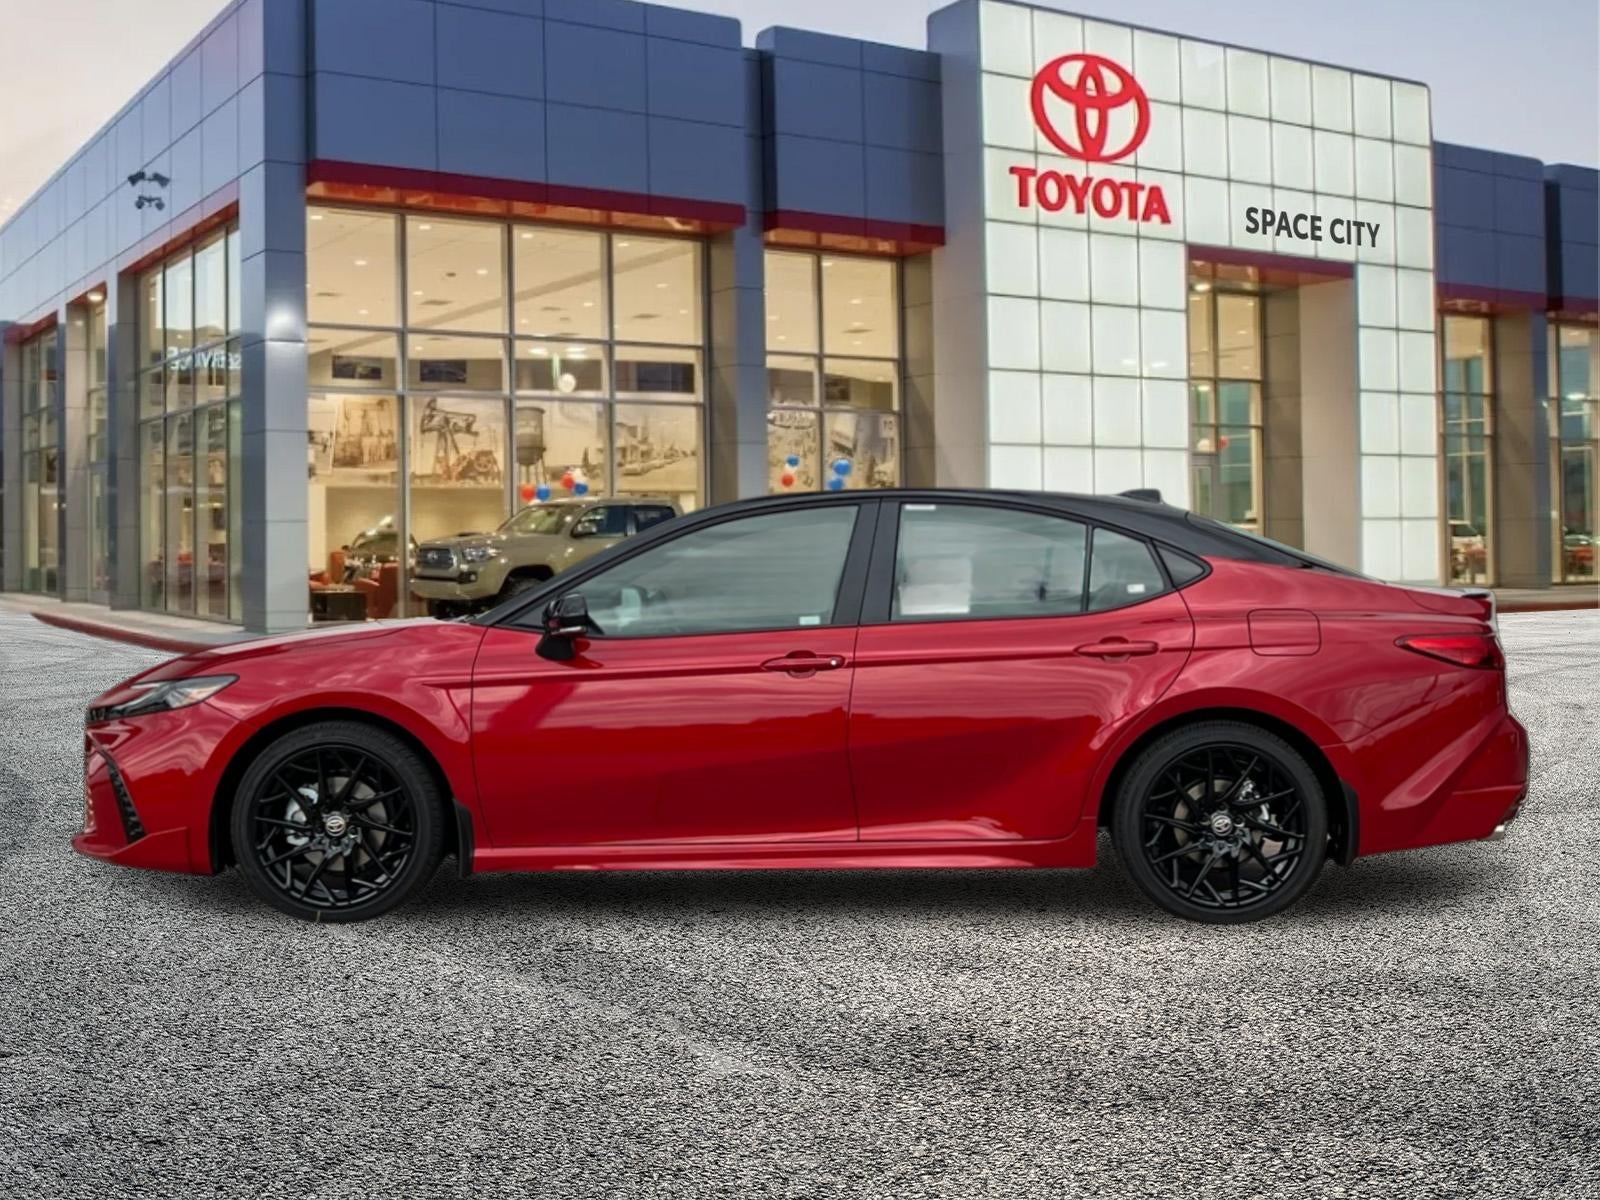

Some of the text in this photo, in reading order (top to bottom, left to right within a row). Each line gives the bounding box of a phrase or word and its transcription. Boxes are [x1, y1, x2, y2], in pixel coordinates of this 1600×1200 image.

[1009, 167, 1171, 224] TOYOTA
[1245, 207, 1381, 247] SPACE CITY
